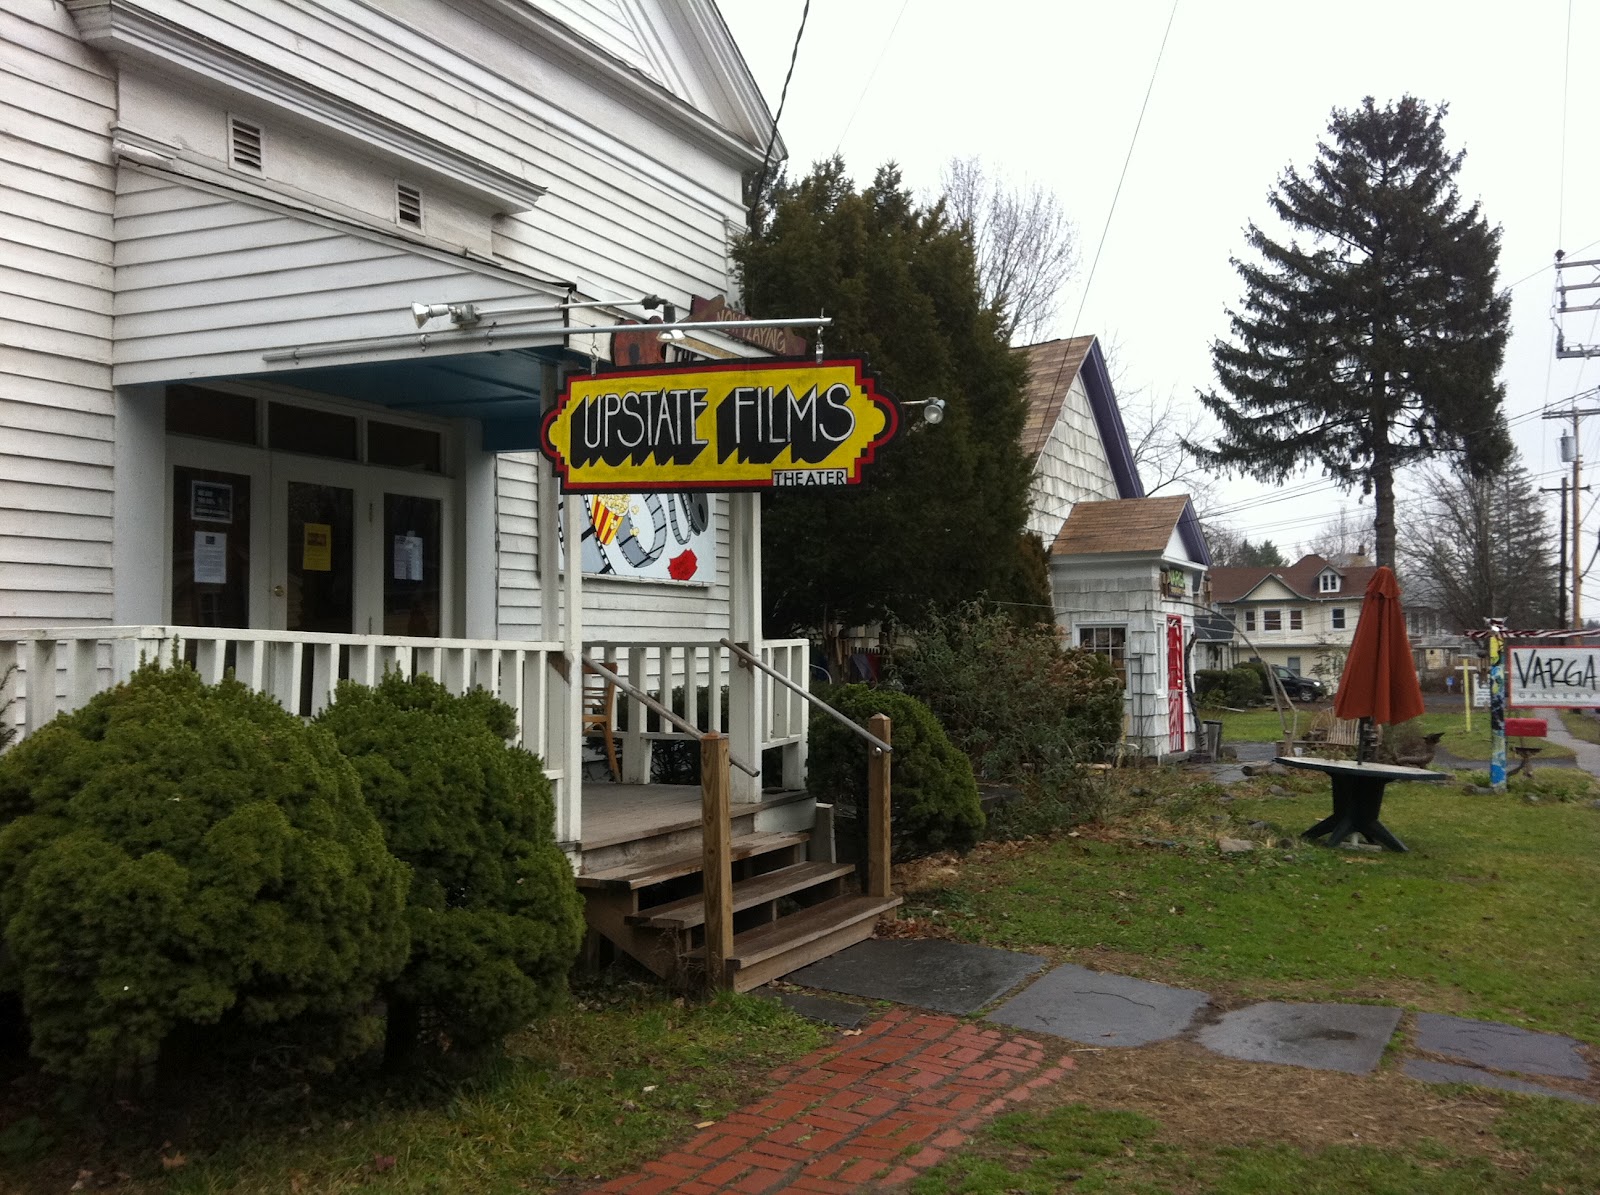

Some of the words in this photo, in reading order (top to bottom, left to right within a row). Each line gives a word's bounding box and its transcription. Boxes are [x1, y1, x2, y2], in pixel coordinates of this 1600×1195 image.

[742, 316, 786, 354] PLAYING
[583, 387, 710, 448] UPSTATE
[733, 382, 856, 444] FILMS
[772, 470, 848, 486] THEATER
[1513, 649, 1598, 691] VARGA
[1518, 691, 1594, 700] GALLERY
